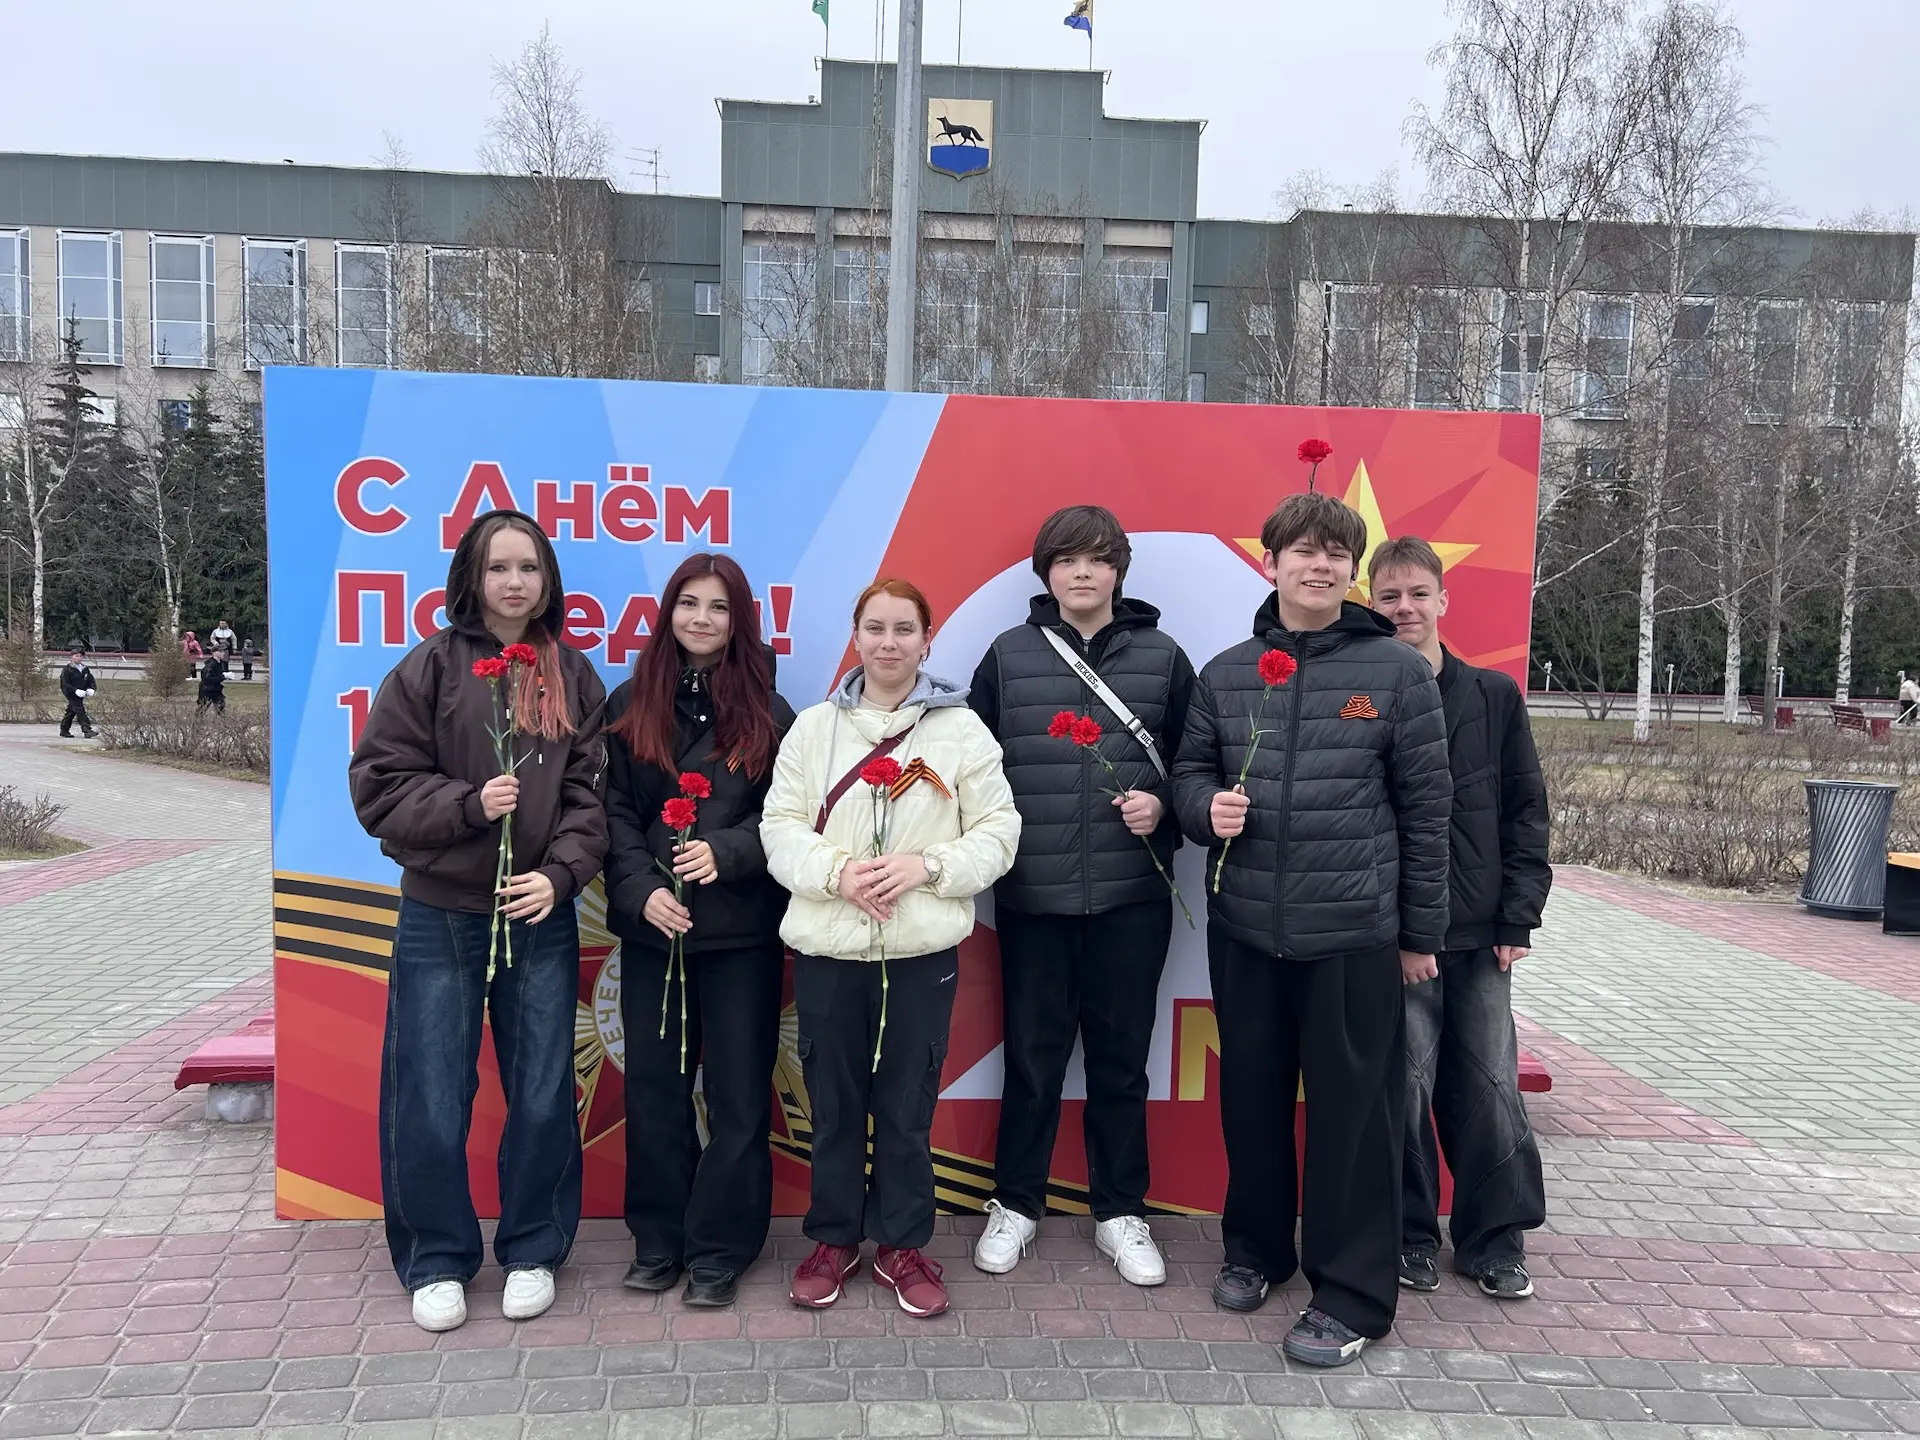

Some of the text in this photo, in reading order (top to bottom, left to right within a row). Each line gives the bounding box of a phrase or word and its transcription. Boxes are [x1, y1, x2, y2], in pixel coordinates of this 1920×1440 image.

[335, 457, 732, 551] С Днём
[336, 570, 794, 666] Поед!
[1074, 661, 1098, 685] DICKIES
